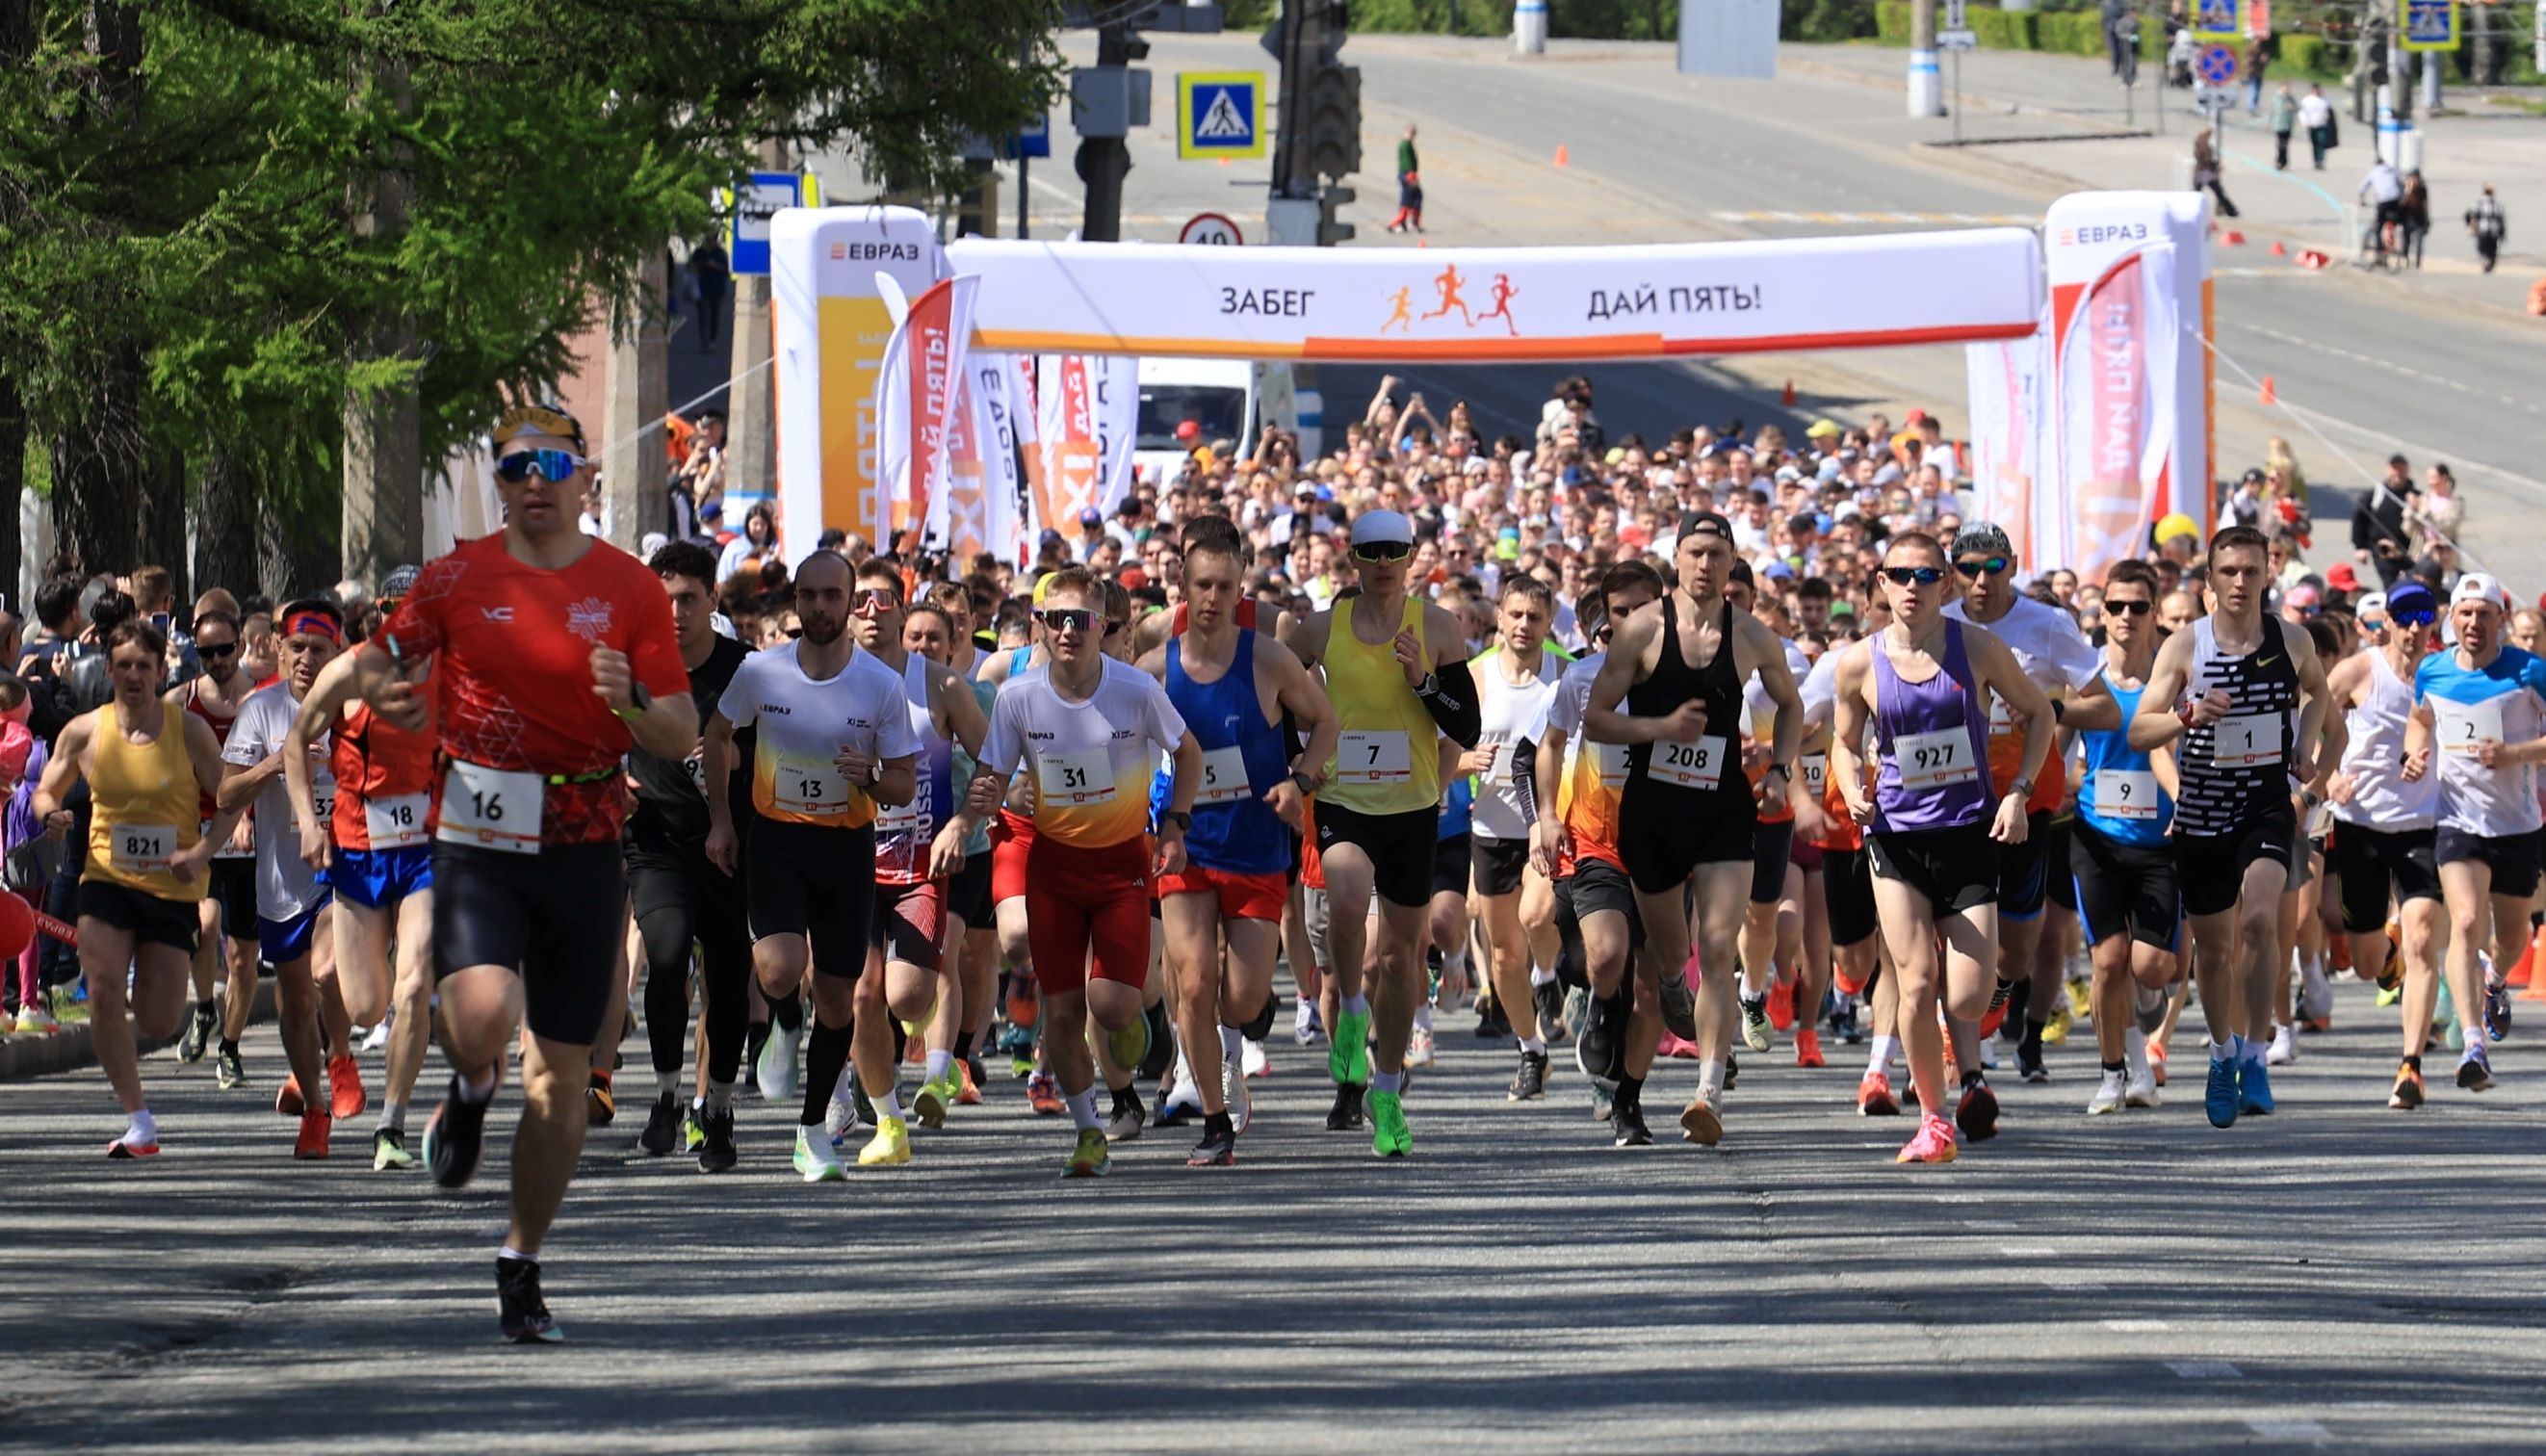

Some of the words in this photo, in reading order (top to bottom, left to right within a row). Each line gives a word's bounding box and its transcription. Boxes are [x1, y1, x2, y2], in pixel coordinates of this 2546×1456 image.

[2077, 222, 2147, 244] ЕВРАЗ
[849, 243, 919, 260] ЕВРАЗ
[1220, 287, 1315, 317] ЗАБЕГ
[1587, 283, 1657, 321] ДАЙ
[1669, 284, 1762, 313] ПЯТЬ!
[924, 327, 947, 417] ПЯТЬ!
[764, 703, 792, 715] ЕВРАЗ
[2245, 729, 2252, 749] 1
[2465, 721, 2476, 740] 2
[1367, 744, 1380, 765] 7
[1665, 744, 1709, 769] 208
[1914, 742, 1955, 770] 927
[1063, 767, 1087, 788] 31
[1205, 766, 1216, 785] 5
[799, 779, 822, 798] 13
[915, 752, 933, 845] RUSSIA
[2120, 782, 2131, 801] 9
[390, 804, 413, 826] 18
[472, 791, 503, 820] 16
[126, 836, 160, 856] 821
